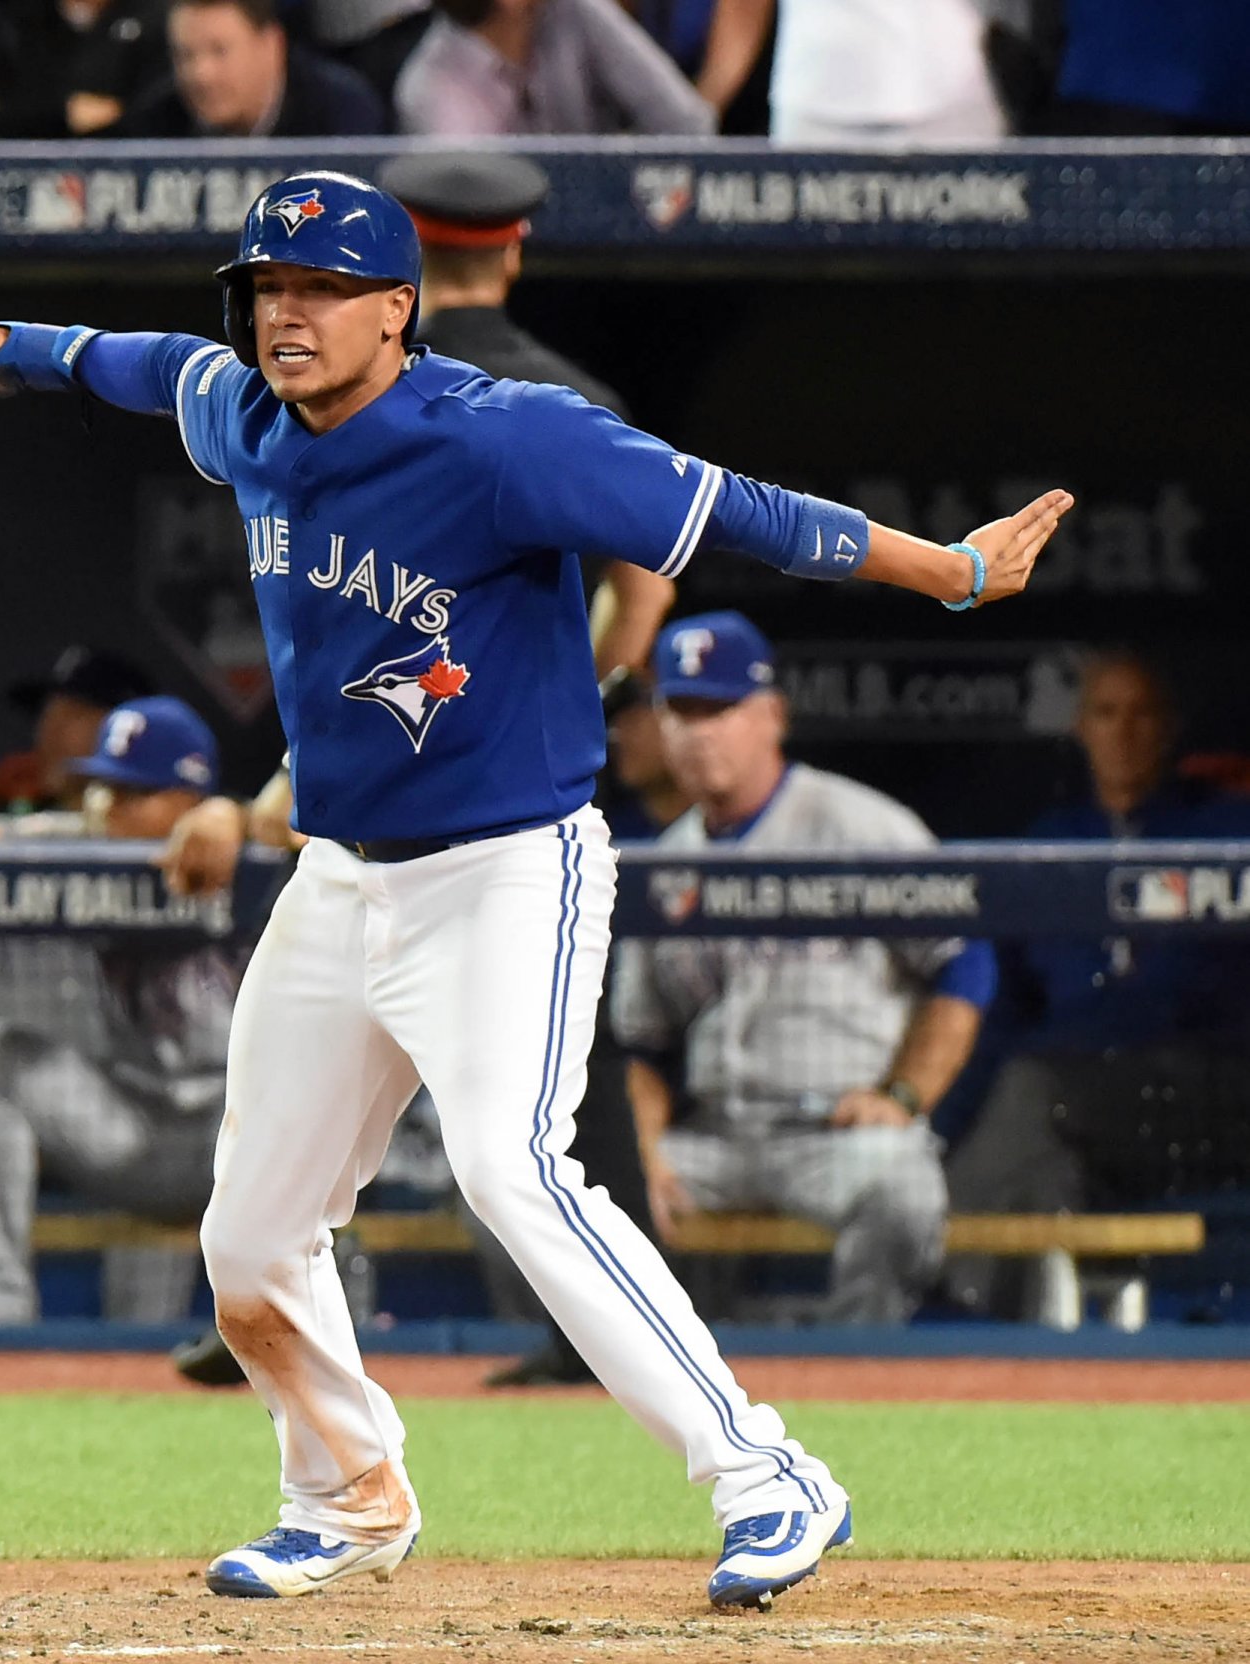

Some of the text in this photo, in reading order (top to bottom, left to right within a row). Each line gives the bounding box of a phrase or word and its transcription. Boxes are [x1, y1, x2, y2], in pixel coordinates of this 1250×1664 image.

[698, 170, 1029, 223] MLB NETWORK
[833, 532, 859, 565] 17
[307, 533, 458, 635] JAYS
[704, 873, 979, 920] MLB NETWORK
